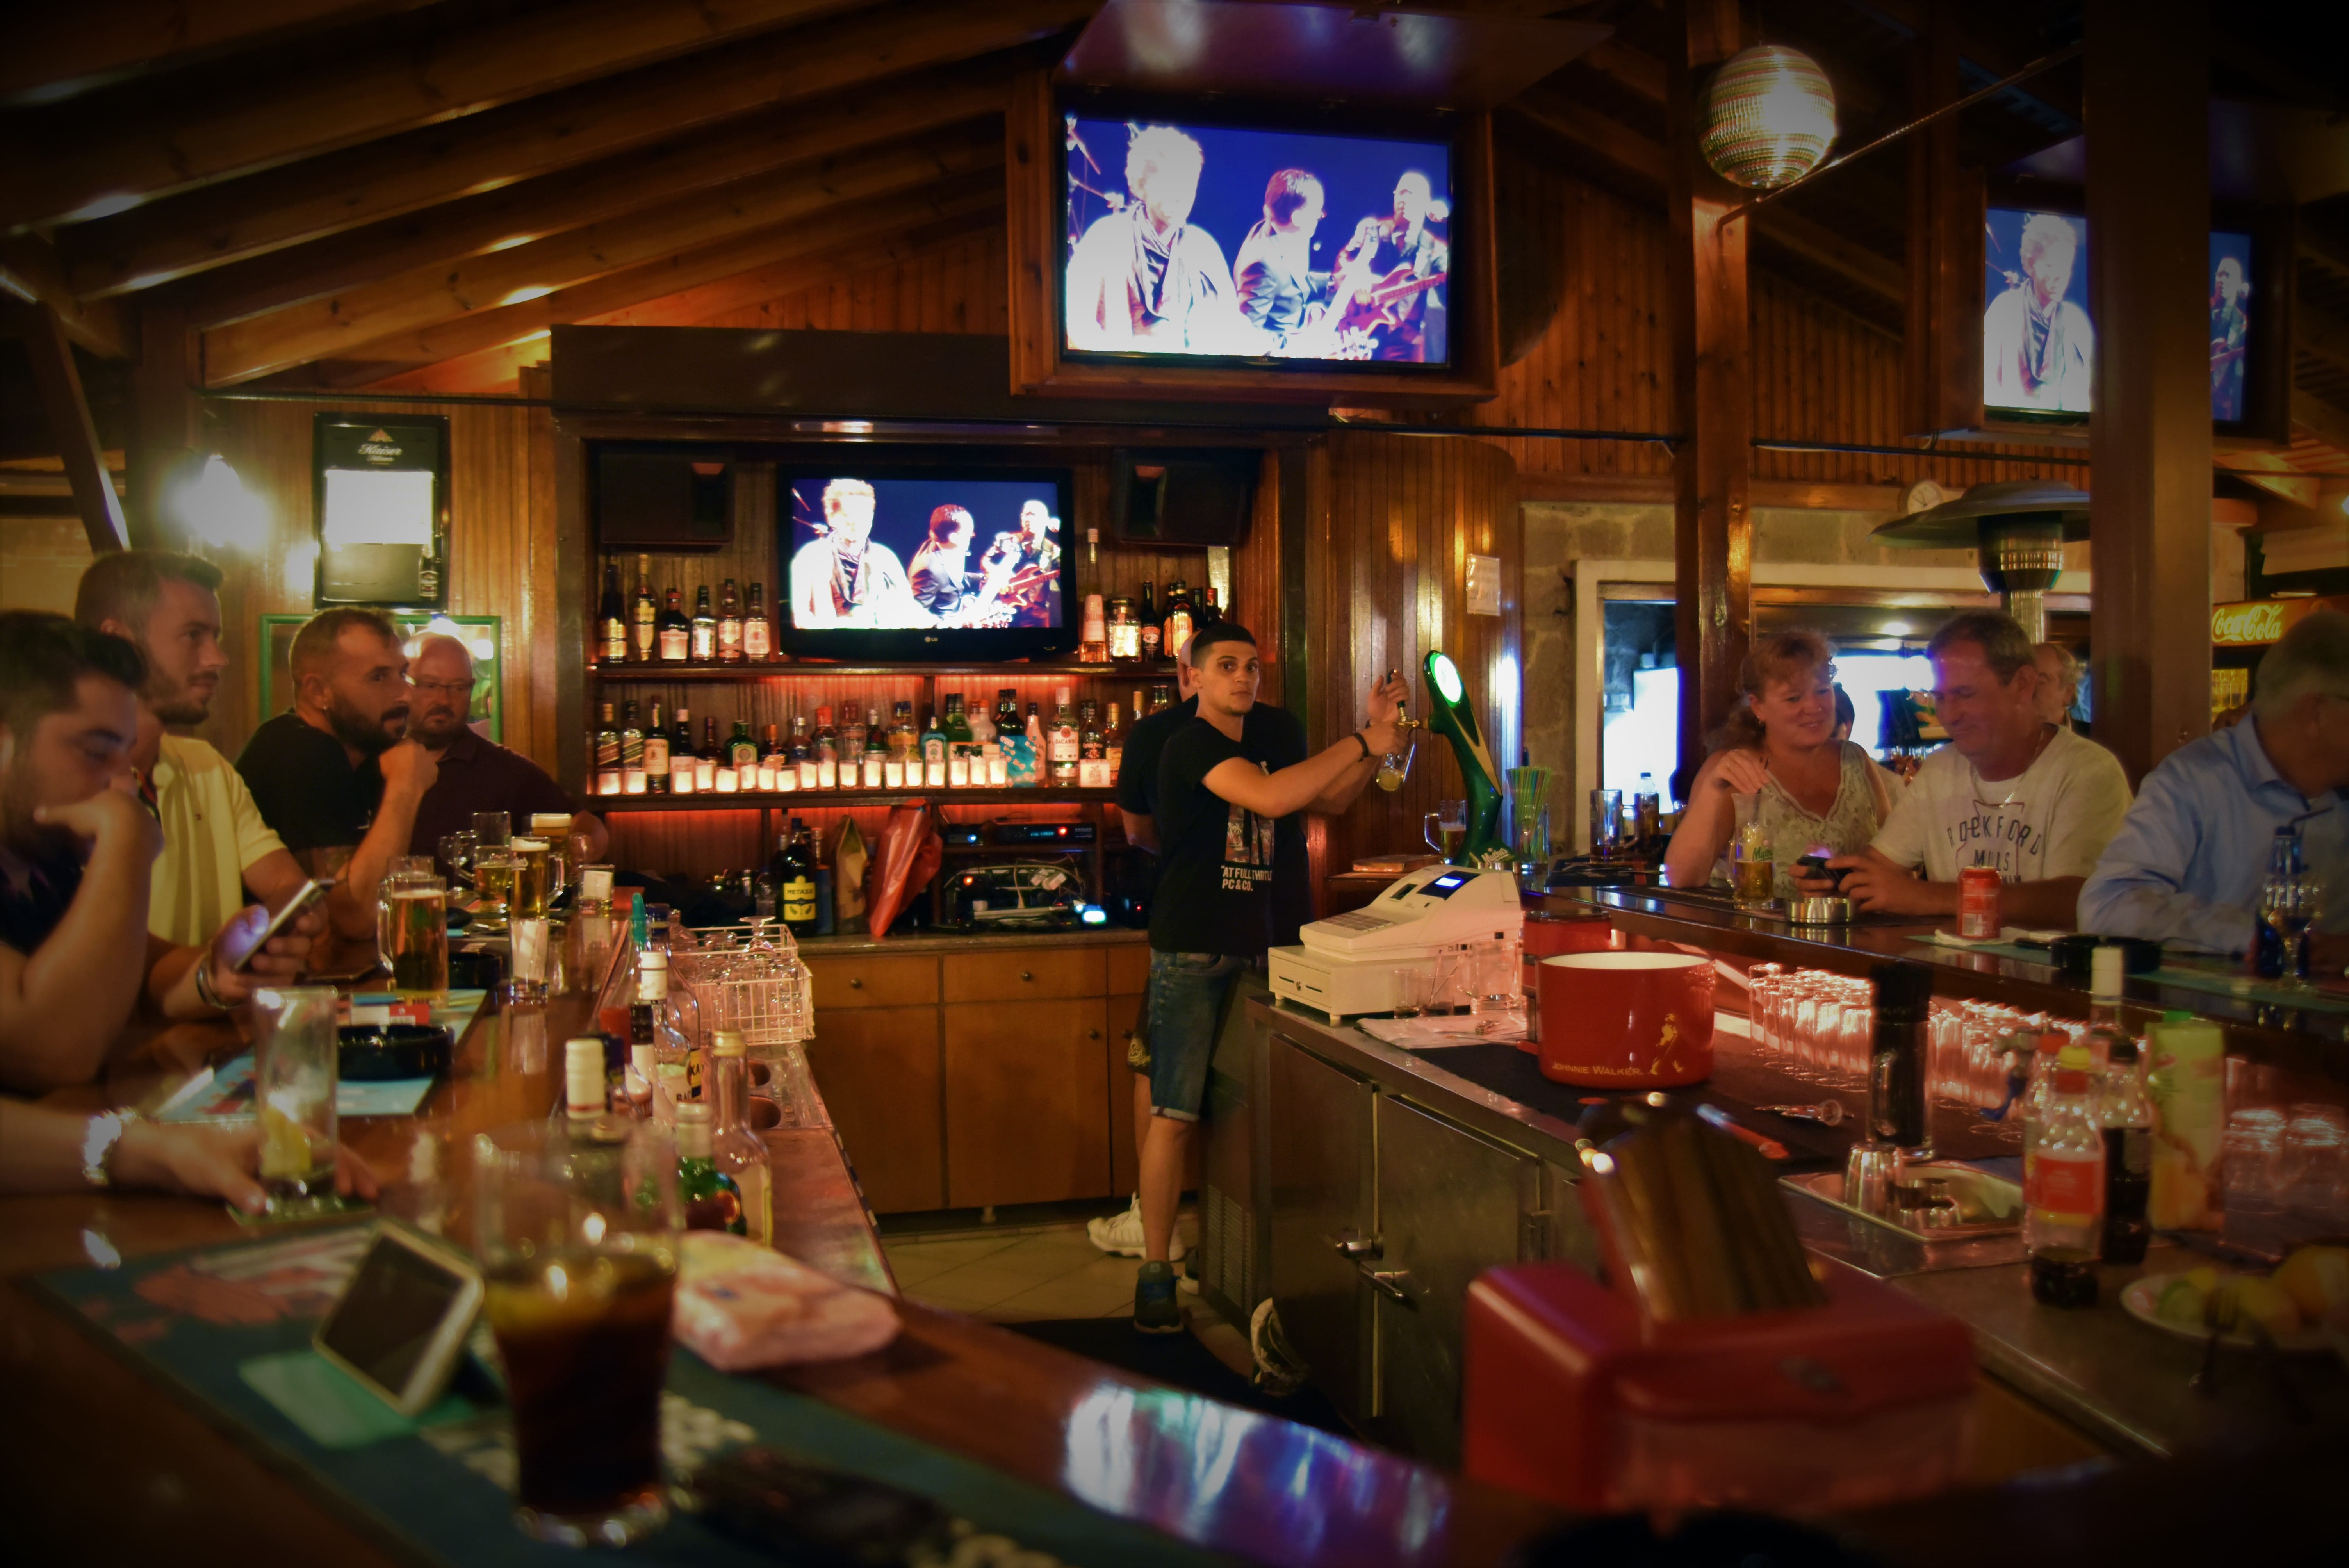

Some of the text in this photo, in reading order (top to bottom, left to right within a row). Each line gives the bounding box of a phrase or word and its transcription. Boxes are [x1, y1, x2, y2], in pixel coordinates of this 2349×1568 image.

[358, 444, 403, 456] Kaiser
[2211, 604, 2284, 643] Coca-Cola
[1947, 815, 2041, 856] ROCKFORD
[1235, 868, 1251, 880] FULL
[1222, 878, 1253, 891] PC & CO.
[1552, 1062, 1641, 1076] JOHNNIE WALKER
